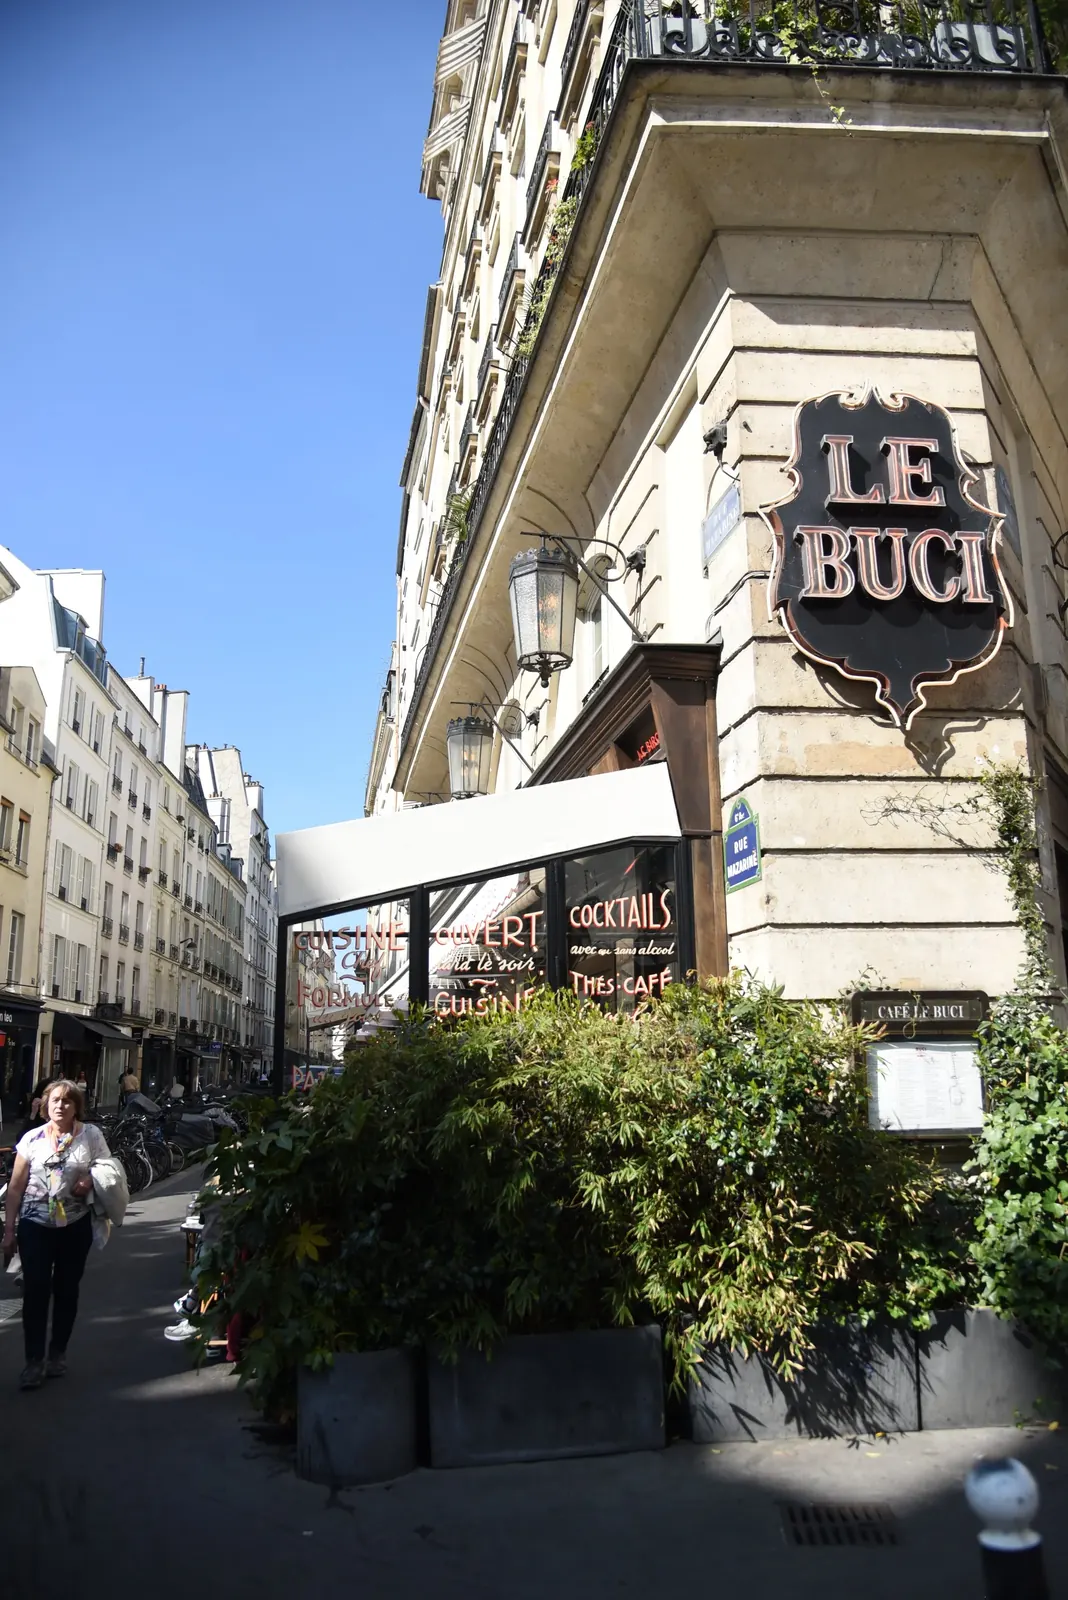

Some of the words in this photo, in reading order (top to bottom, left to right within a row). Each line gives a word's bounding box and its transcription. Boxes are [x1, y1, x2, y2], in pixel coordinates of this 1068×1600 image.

[820, 434, 947, 508] LE
[793, 525, 994, 604] BUCI
[733, 836, 748, 854] RUE
[727, 852, 758, 879] MAZARINE
[569, 889, 671, 930] COCKTAILS
[295, 921, 406, 951] CUISINE
[435, 910, 544, 948] OUVERT
[477, 952, 493, 972] le
[497, 955, 536, 972] soir
[570, 945, 597, 955] avec
[597, 947, 612, 956] ou
[613, 946, 637, 955] sans
[637, 940, 675, 955] alcool
[341, 951, 386, 983] Chef
[623, 966, 673, 996] CAFÉ
[296, 979, 394, 1008] FORMULE
[434, 986, 536, 1019] CUISINE
[877, 1002, 911, 1019] CAFÉ
[913, 1005, 931, 1019] LE
[933, 1005, 964, 1018] BUCI
